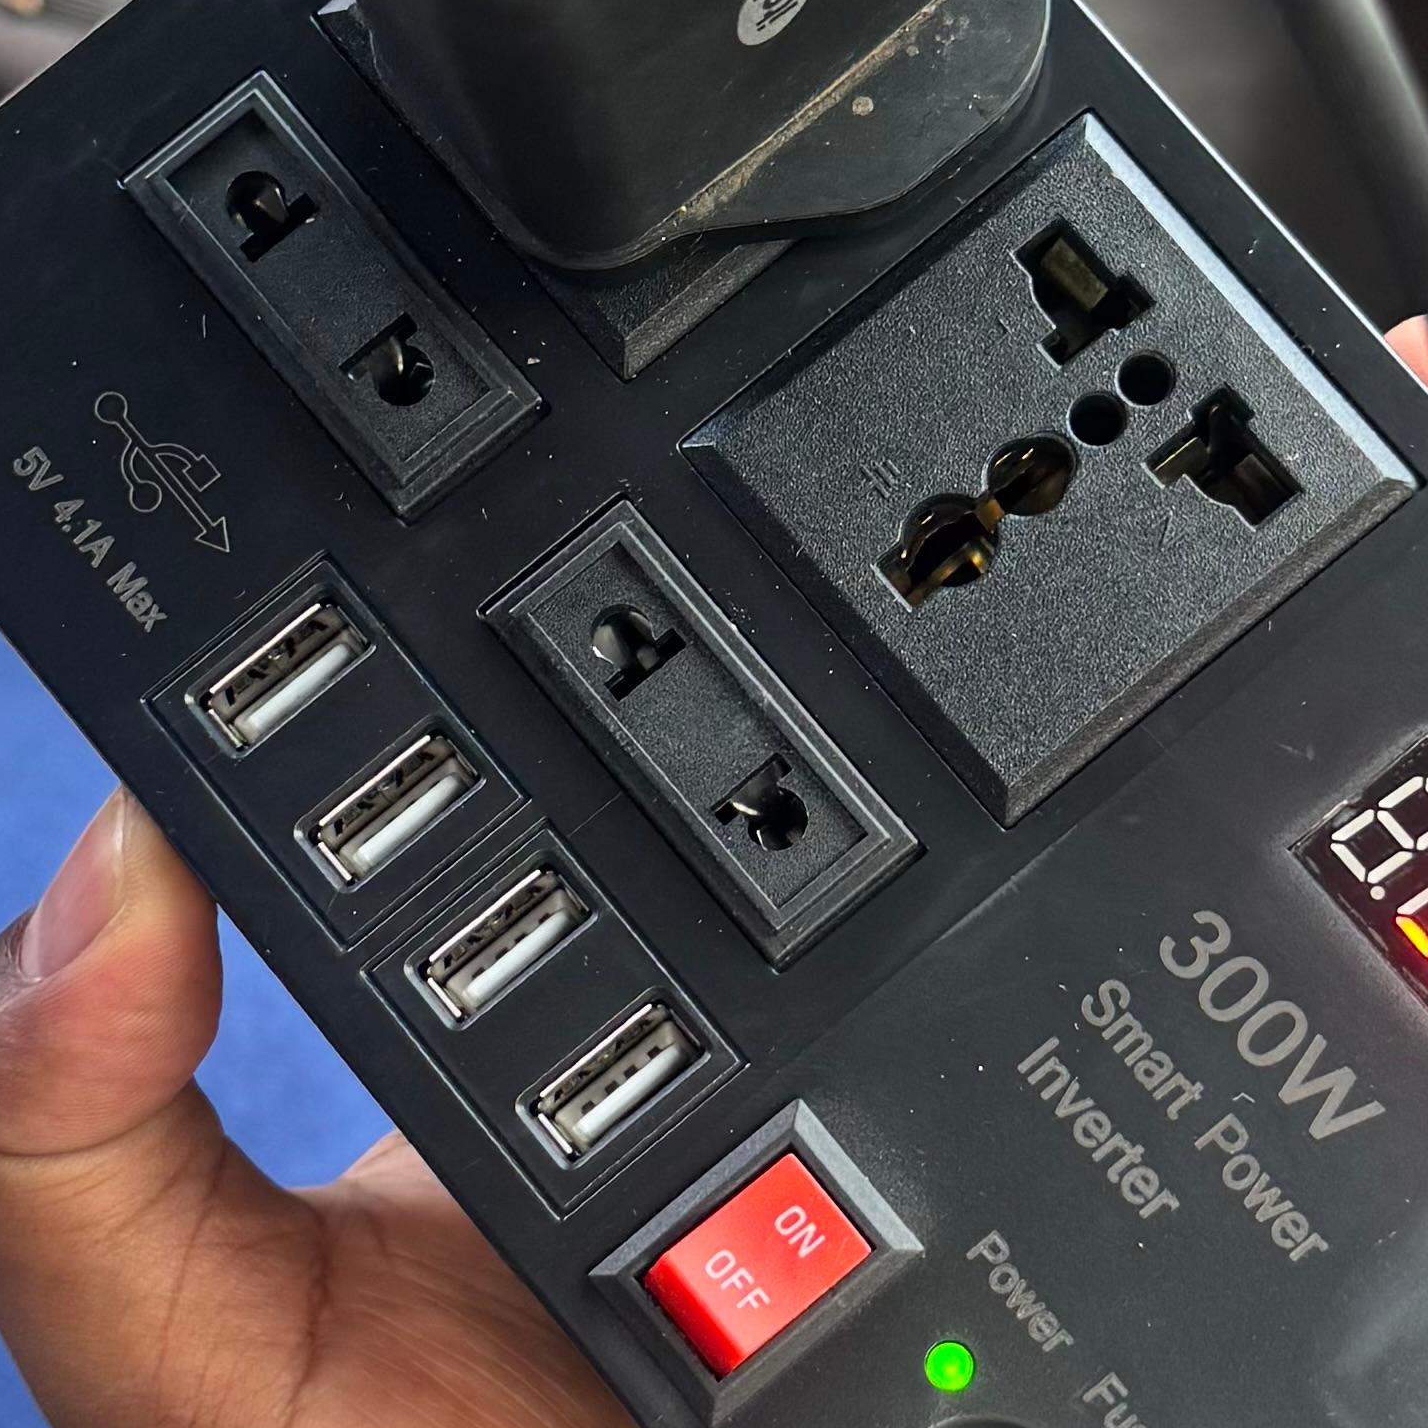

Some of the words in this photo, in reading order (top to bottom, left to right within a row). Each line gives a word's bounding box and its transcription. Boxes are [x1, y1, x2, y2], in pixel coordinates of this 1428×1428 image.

[13, 446, 64, 491] 5V
[53, 498, 115, 568] 4.1A
[106, 561, 168, 633] Max
[1159, 910, 1386, 1140] 300W
[1017, 1036, 1180, 1219] Inverter
[1081, 979, 1204, 1121] Smart
[1194, 1113, 1329, 1262] Power
[704, 1249, 771, 1309] OFF
[774, 1205, 826, 1259] ON
[966, 1230, 1074, 1352] Power
